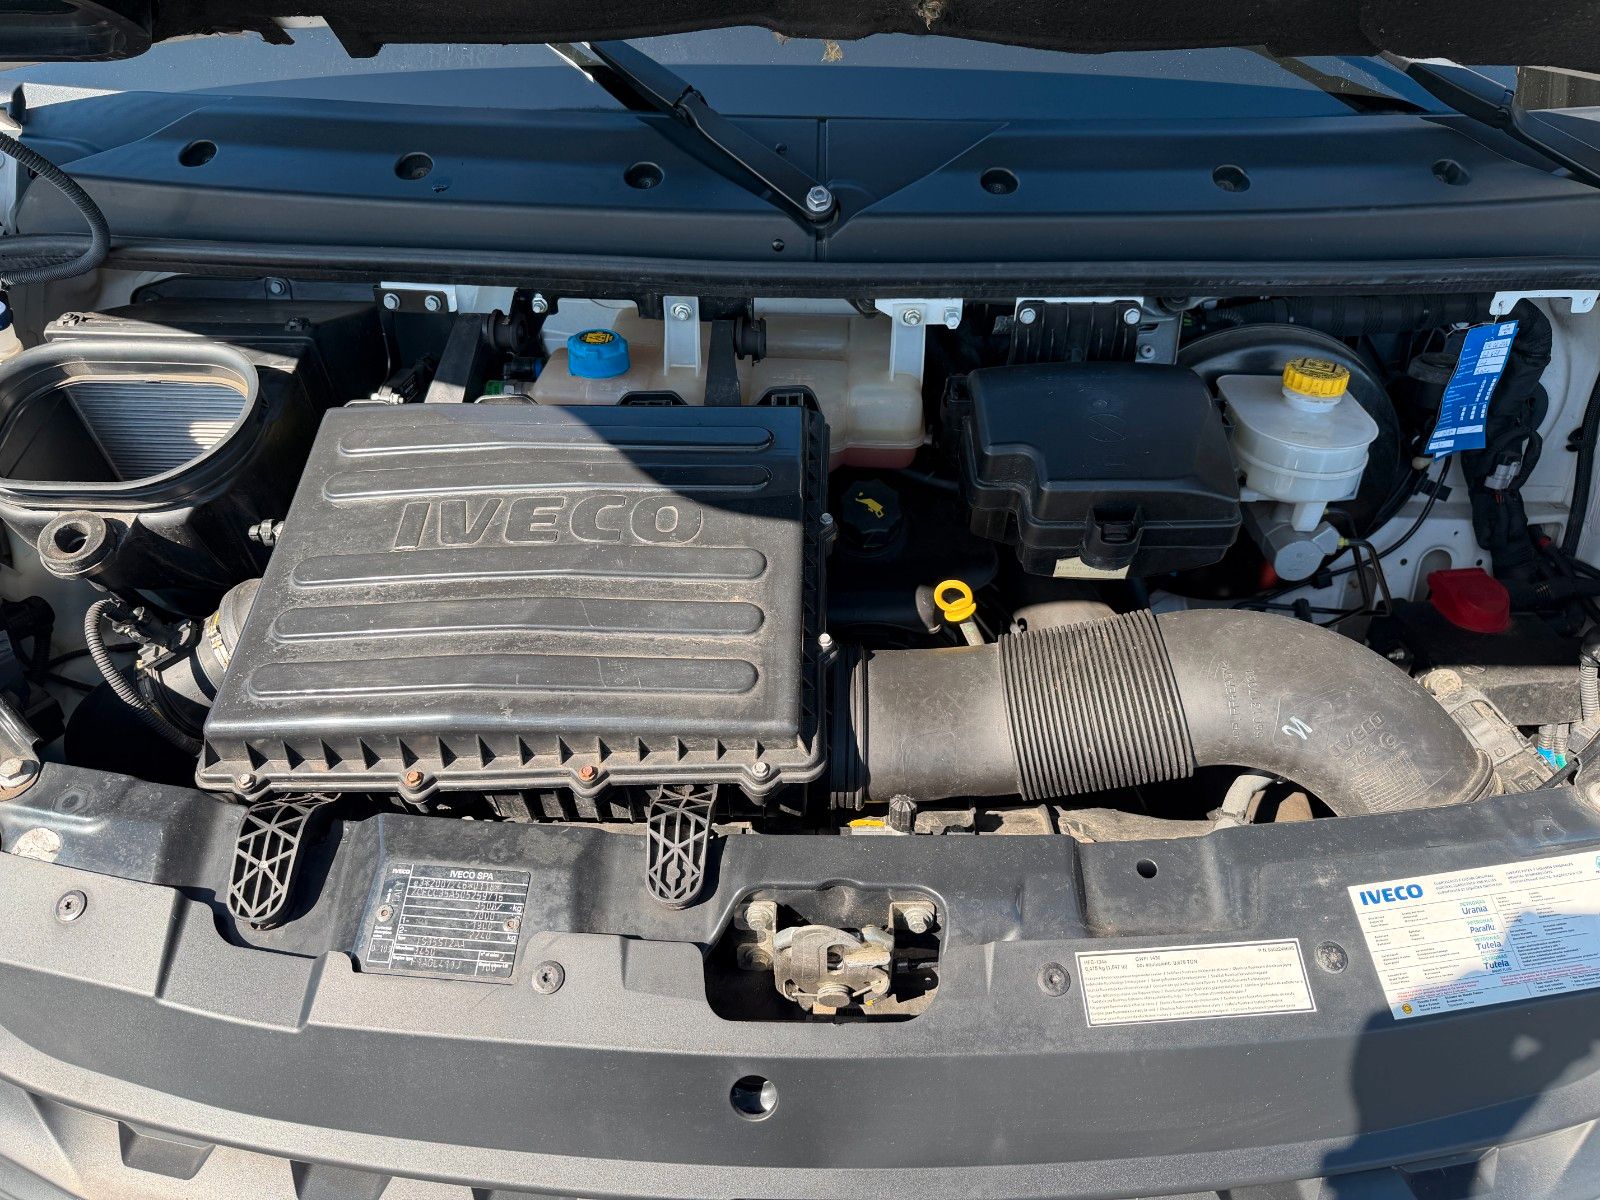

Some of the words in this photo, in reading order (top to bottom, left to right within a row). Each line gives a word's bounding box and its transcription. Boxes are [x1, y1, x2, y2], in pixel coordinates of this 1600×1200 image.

[394, 495, 703, 548] IVECO
[449, 870, 476, 879] IVECO
[476, 871, 494, 880] SPA
[1359, 884, 1424, 906] IVECO
[1461, 905, 1488, 915] Urania
[1470, 923, 1496, 933] Paraflu
[506, 933, 517, 943] kg
[1475, 941, 1502, 950] Tutela
[1483, 960, 1510, 969] Tutela
